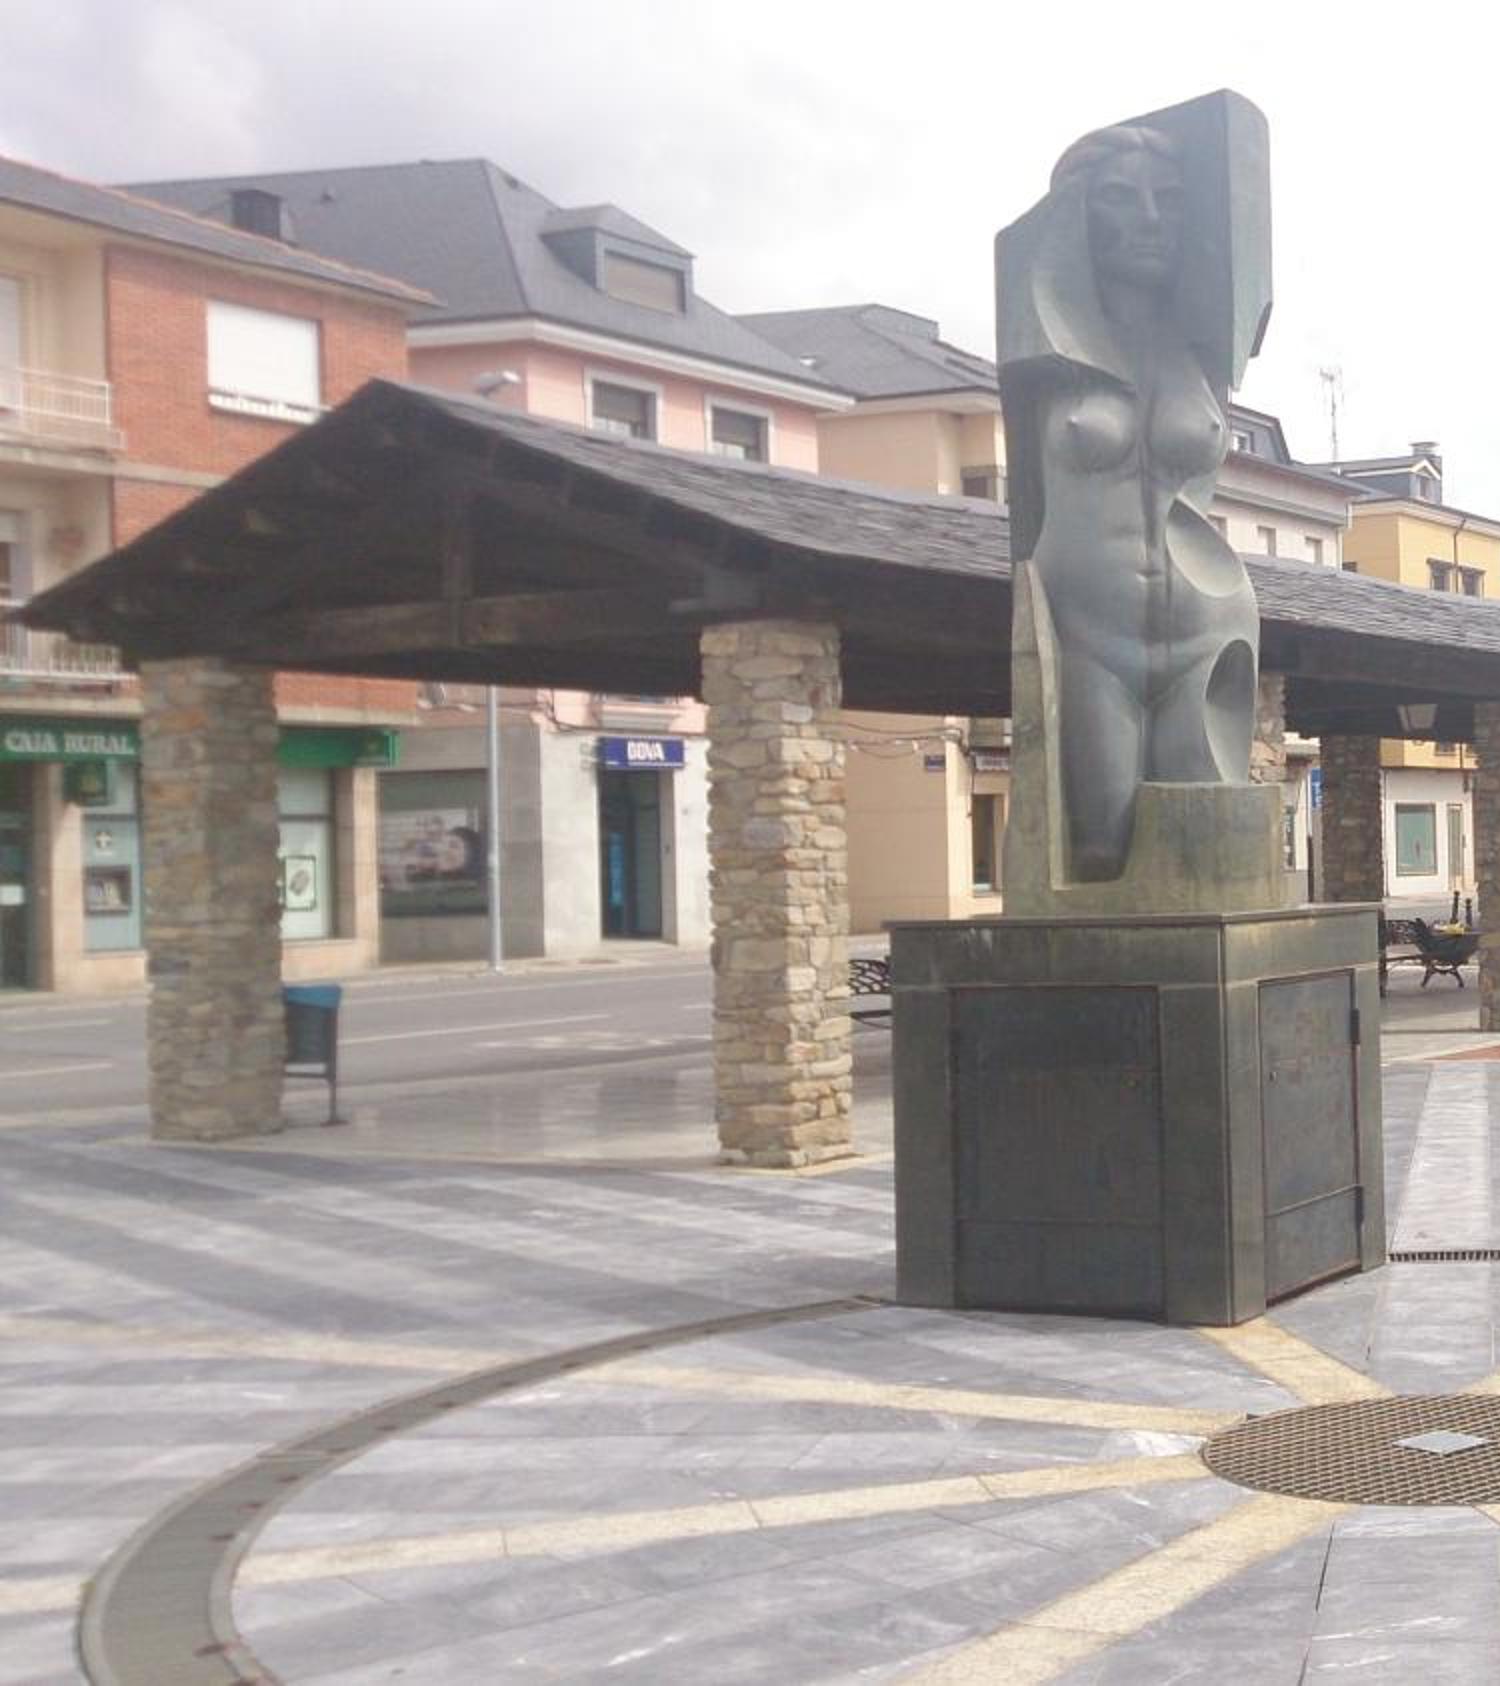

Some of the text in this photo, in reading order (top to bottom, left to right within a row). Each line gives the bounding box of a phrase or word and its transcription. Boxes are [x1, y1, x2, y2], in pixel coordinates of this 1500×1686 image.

[5, 731, 135, 755] CAJA RURAL
[627, 741, 665, 761] BBVA
